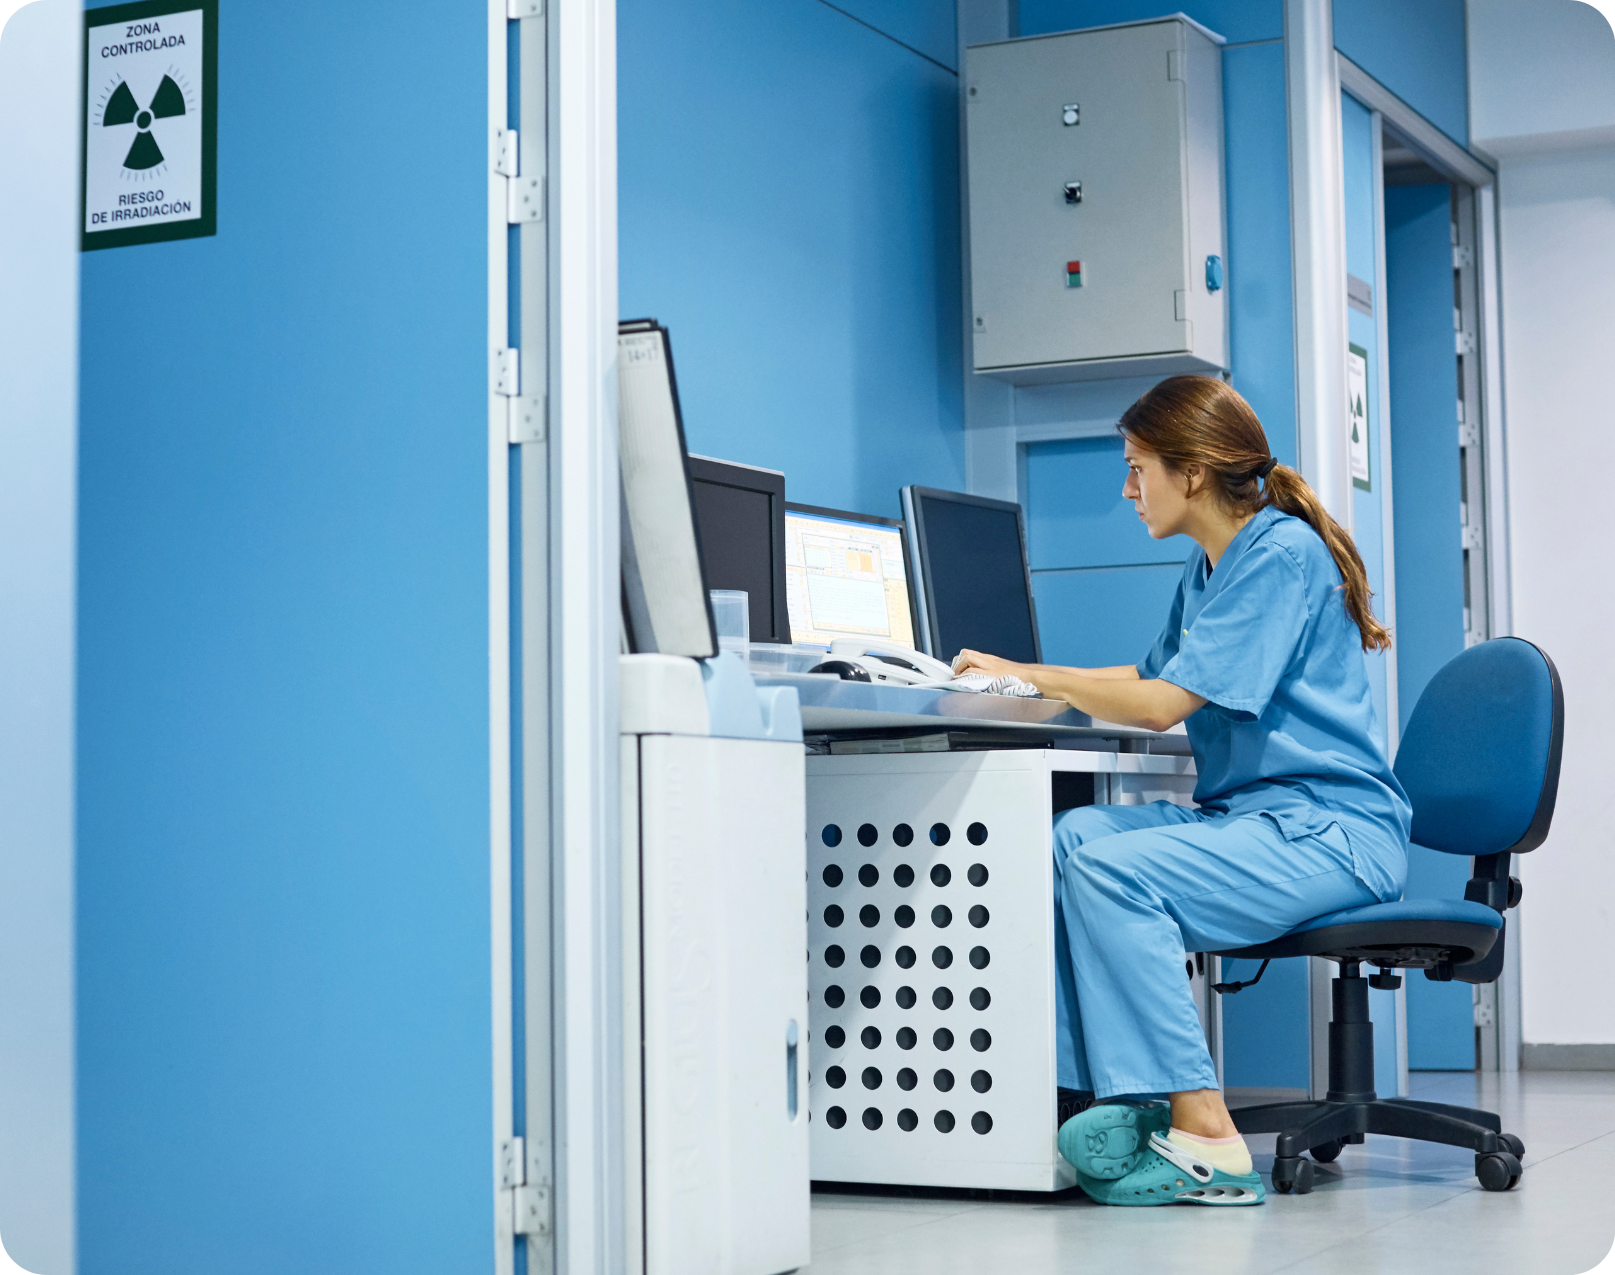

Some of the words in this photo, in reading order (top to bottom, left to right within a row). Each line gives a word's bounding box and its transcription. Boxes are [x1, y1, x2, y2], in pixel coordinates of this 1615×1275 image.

[126, 22, 160, 38] ZONA
[101, 35, 185, 58] CONTROLADA
[119, 190, 164, 206] RIESGO
[92, 212, 108, 224] DE
[111, 199, 191, 222] IRRADIACIÓN
